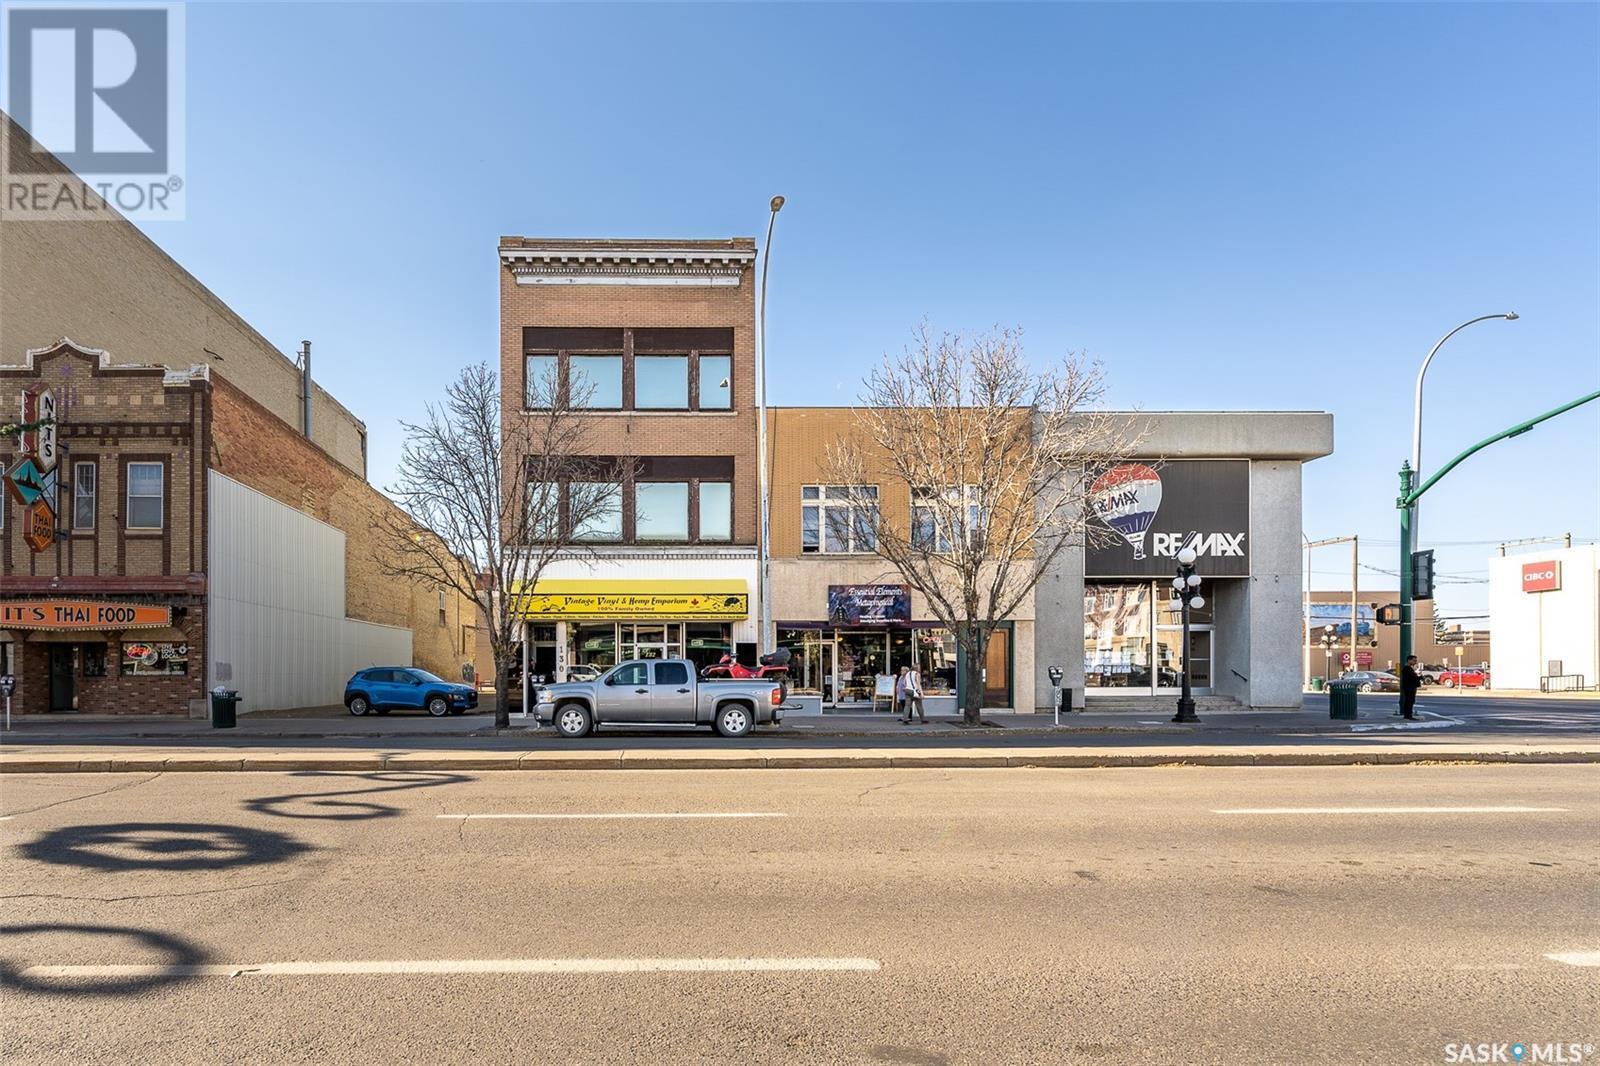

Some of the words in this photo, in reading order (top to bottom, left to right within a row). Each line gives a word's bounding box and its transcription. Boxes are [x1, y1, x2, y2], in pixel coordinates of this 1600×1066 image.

[33, 524, 52, 539] FOOD
[1153, 531, 1245, 559] RE/MAX
[1524, 572, 1546, 581] CIBC
[564, 597, 594, 606] Vintage
[597, 597, 620, 606] Vinyl
[621, 597, 627, 605] &
[629, 597, 650, 607] Hemp
[651, 597, 688, 606] Emporium
[5, 607, 46, 621] IT'S
[54, 607, 90, 622] THAI
[98, 607, 136, 623] FOOD
